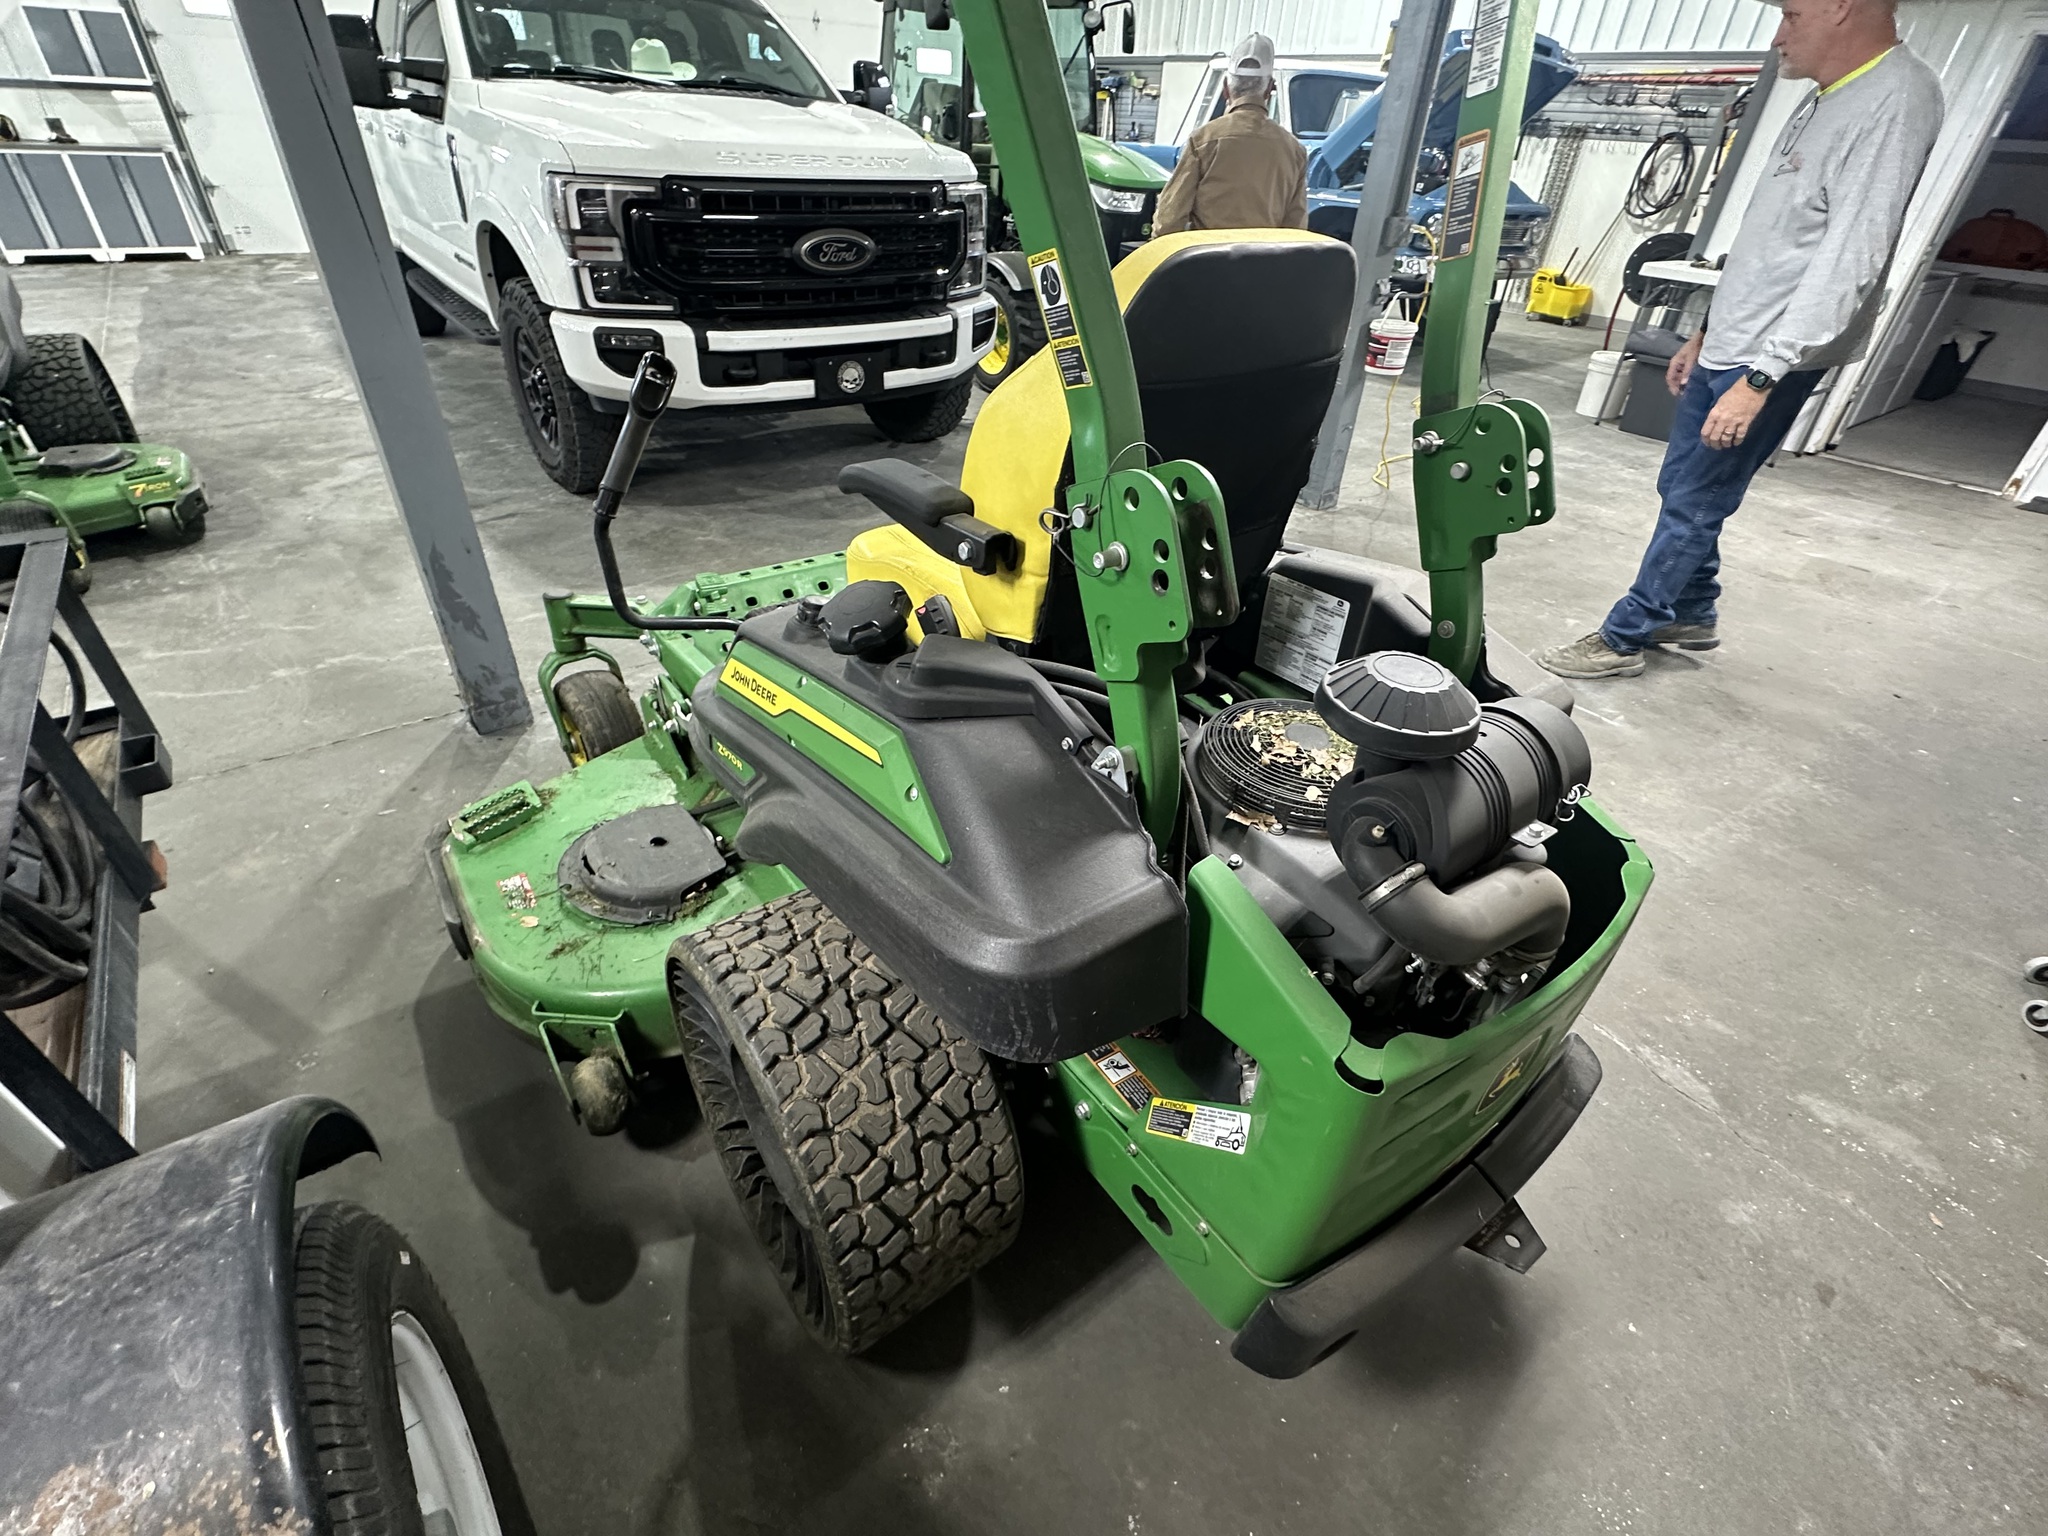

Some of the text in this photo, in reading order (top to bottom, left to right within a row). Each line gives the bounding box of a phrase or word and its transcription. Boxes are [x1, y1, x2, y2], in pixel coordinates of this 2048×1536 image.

[716, 151, 909, 168] SUPER DUTY
[819, 242, 857, 263] Ford
[1033, 251, 1055, 263] CAUTION
[731, 666, 778, 706] JOHN DEERE
[1164, 1099, 1188, 1111] ATENCIÓN
